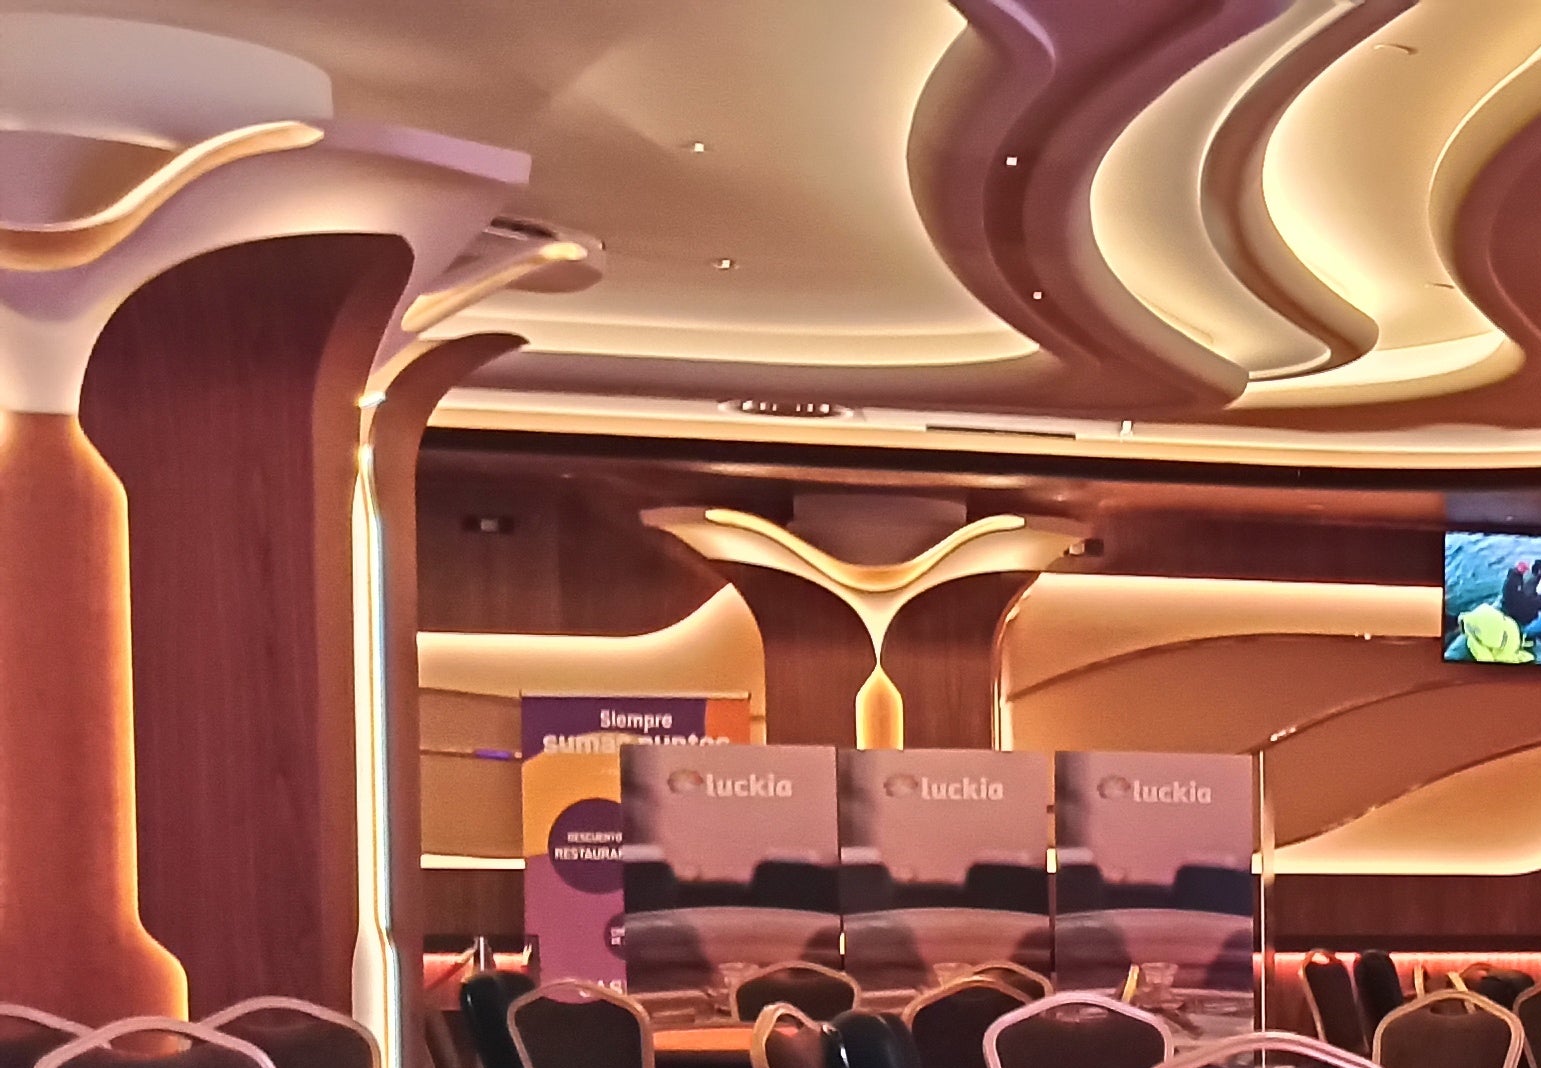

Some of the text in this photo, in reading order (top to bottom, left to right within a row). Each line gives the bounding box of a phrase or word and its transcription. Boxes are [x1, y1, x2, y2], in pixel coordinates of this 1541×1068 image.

[600, 709, 673, 733] Siempre
[706, 773, 793, 797] luckia
[921, 777, 1003, 800] luckia
[1133, 780, 1211, 803] luckia
